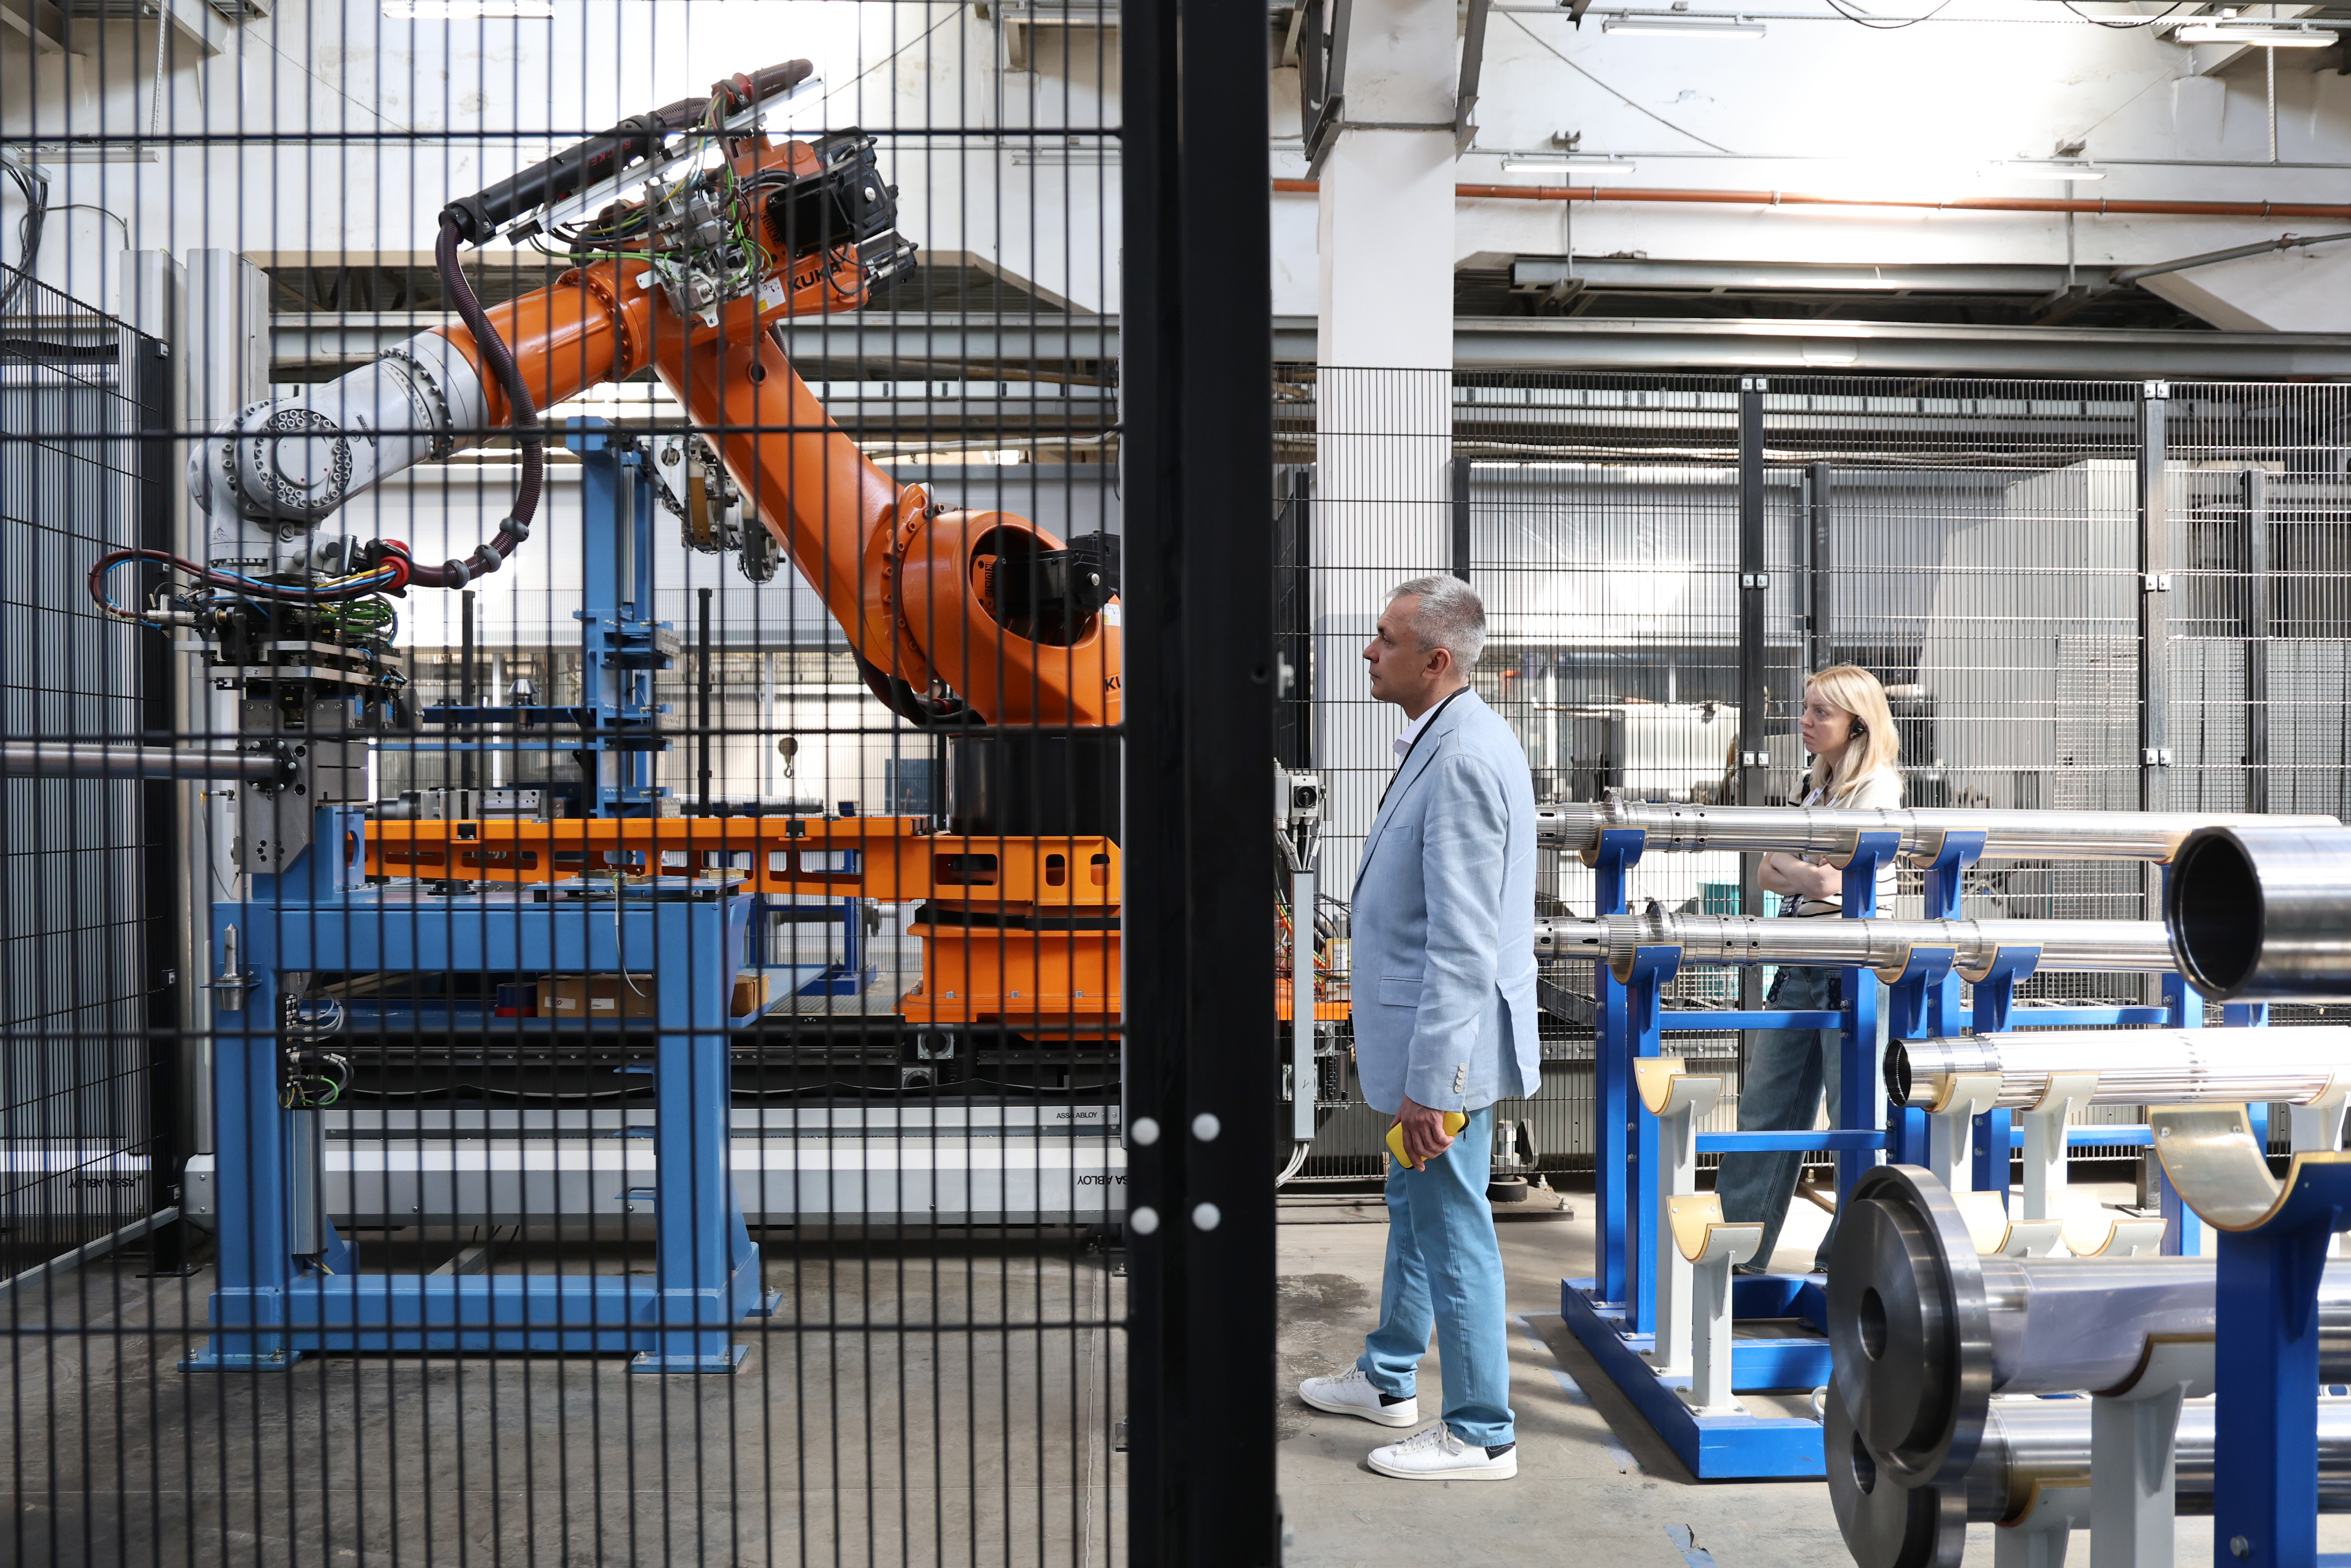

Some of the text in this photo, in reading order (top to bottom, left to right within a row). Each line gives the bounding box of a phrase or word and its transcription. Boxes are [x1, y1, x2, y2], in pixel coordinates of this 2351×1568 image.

[788, 261, 843, 291] KUKA
[985, 564, 994, 597] KUKA
[1077, 1175, 1113, 1185] ABLOY
